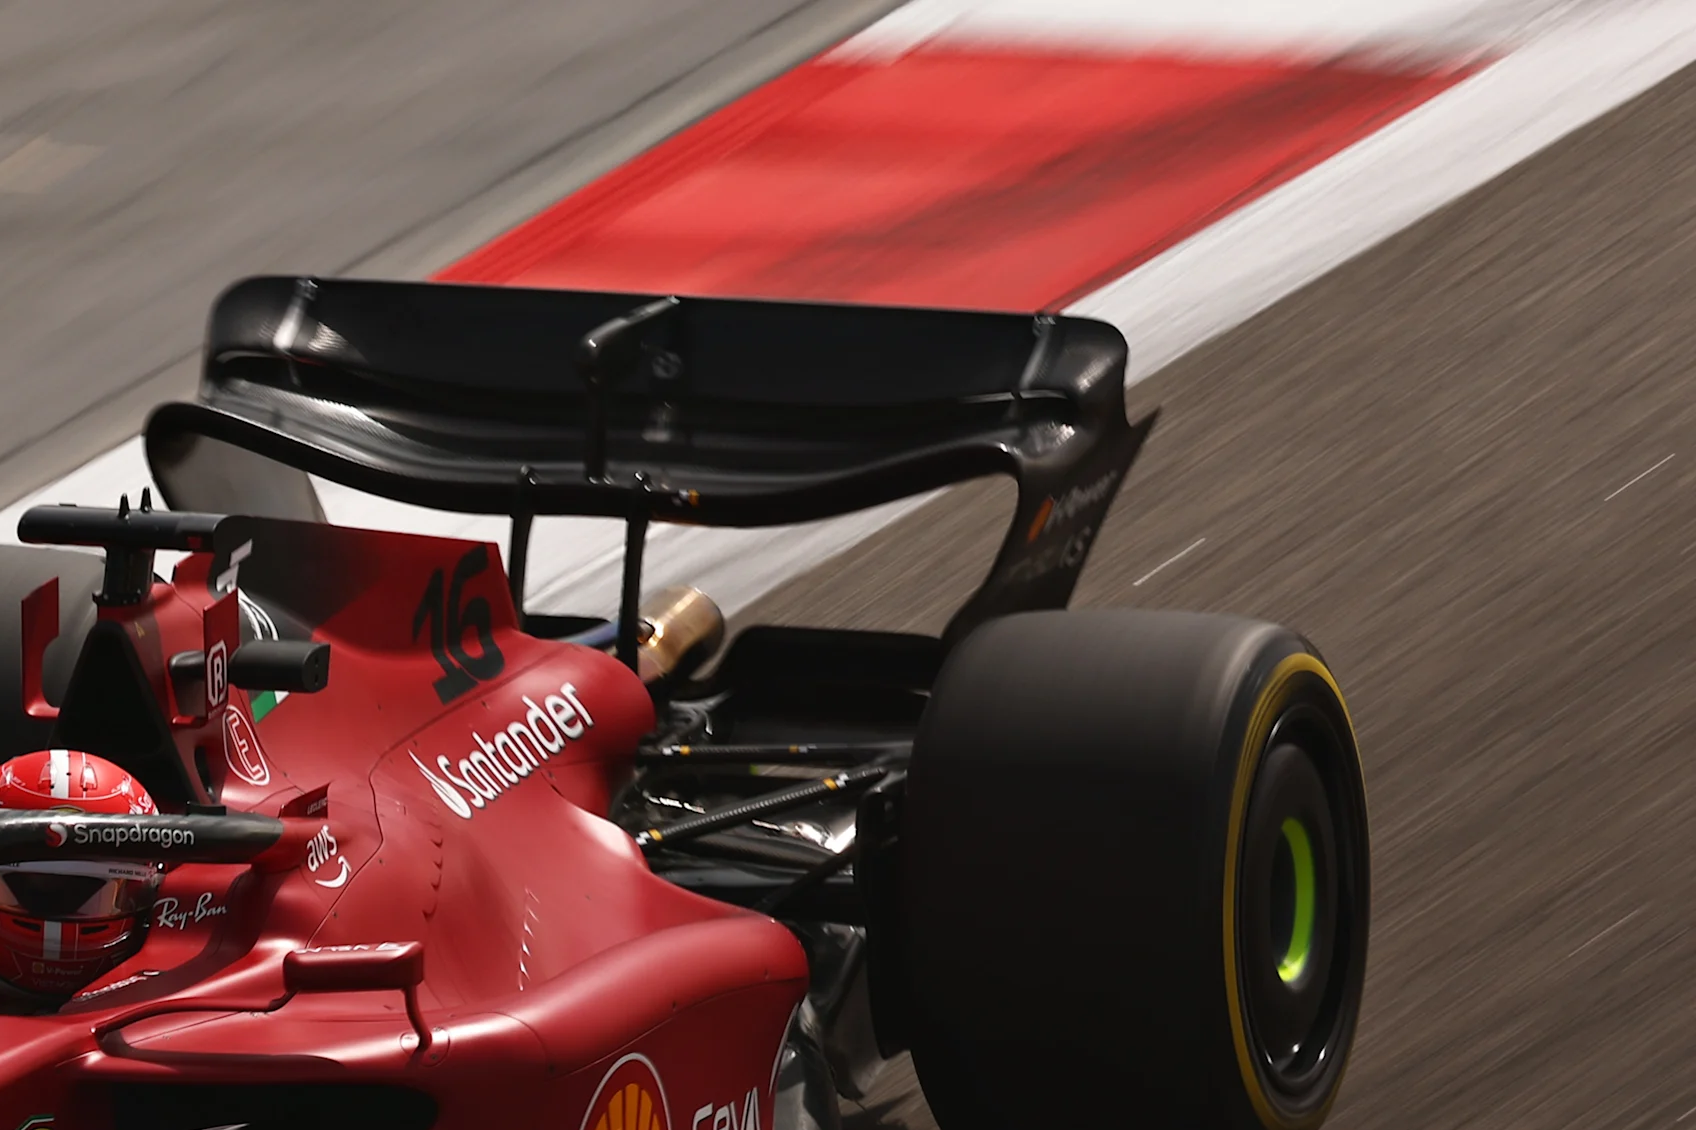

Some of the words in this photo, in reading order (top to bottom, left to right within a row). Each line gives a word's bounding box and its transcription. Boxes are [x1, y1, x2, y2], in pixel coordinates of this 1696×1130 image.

[413, 545, 507, 706] 16
[435, 682, 595, 819] Santander
[73, 824, 195, 849] Snapdragon
[306, 825, 337, 872] aws
[154, 892, 227, 929] Ray-Ban
